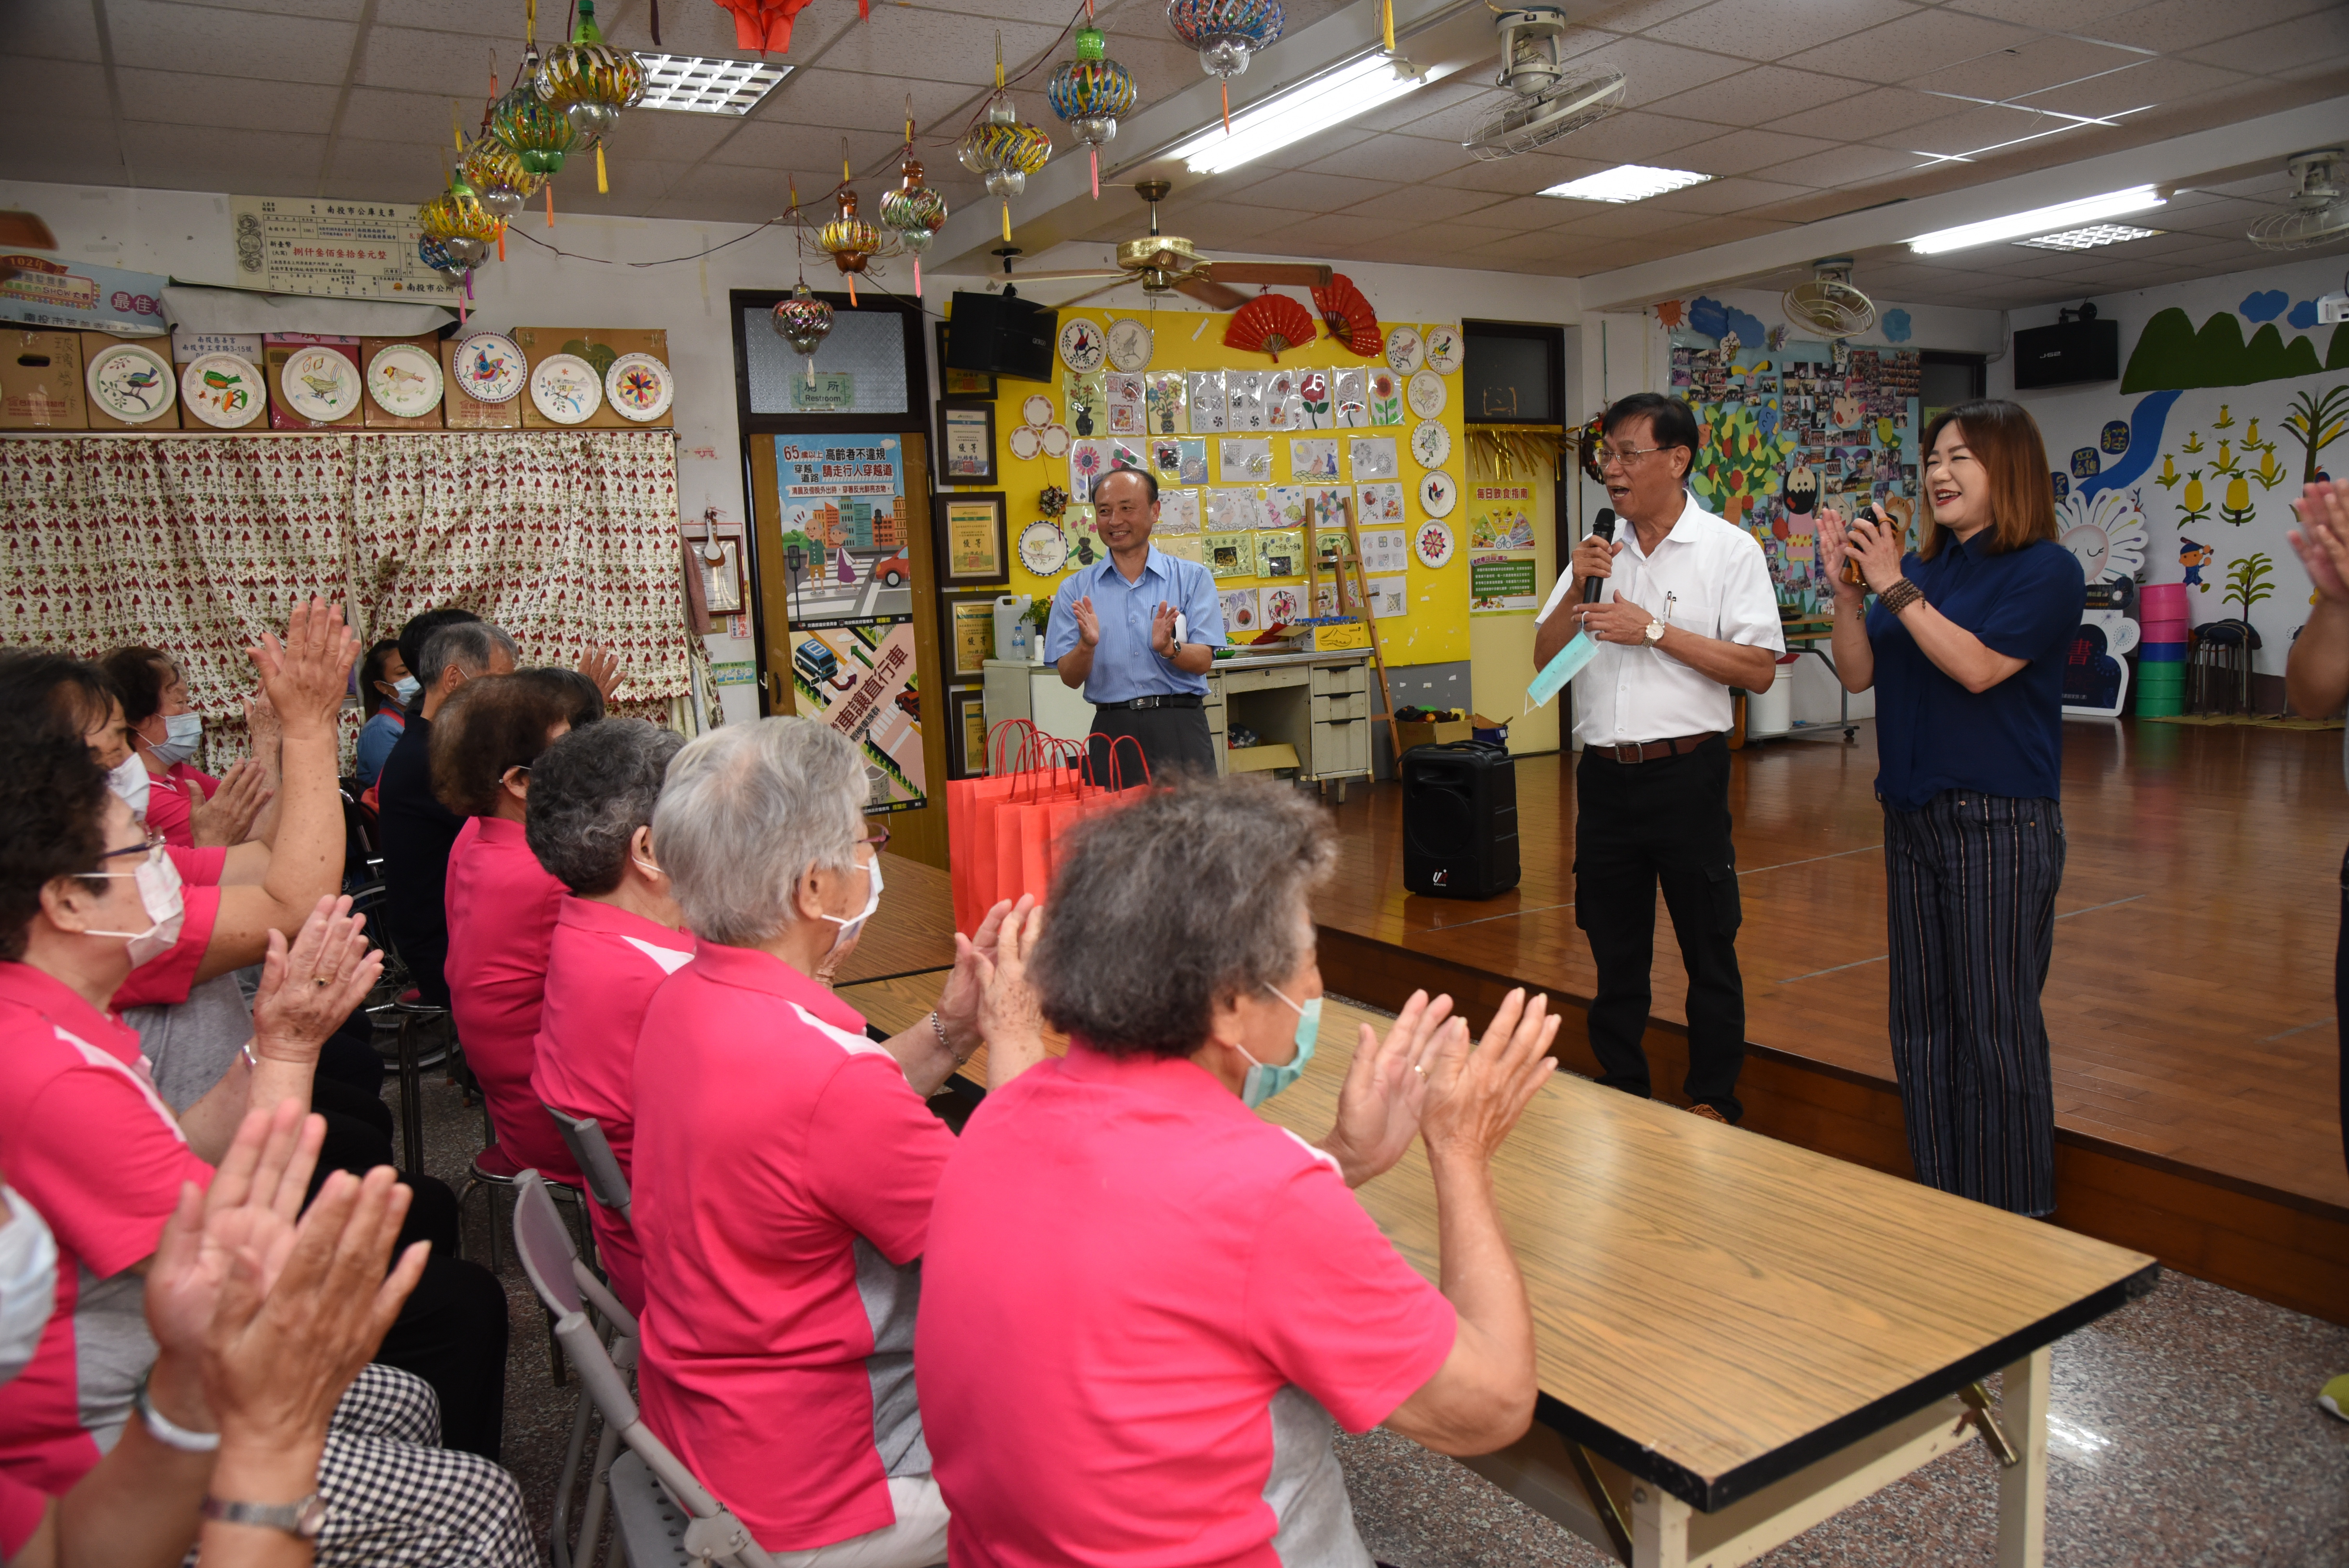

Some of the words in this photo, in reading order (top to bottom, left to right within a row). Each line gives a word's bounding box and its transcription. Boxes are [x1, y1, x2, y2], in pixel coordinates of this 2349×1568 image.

[327, 205, 395, 217] 南投市公庫支票
[825, 448, 886, 461] 高齡者不違規
[794, 464, 813, 474] 穿越
[823, 463, 893, 477] 請走行人穿越道
[802, 474, 819, 483] 道路
[1477, 488, 1528, 500] 每日飲食指南
